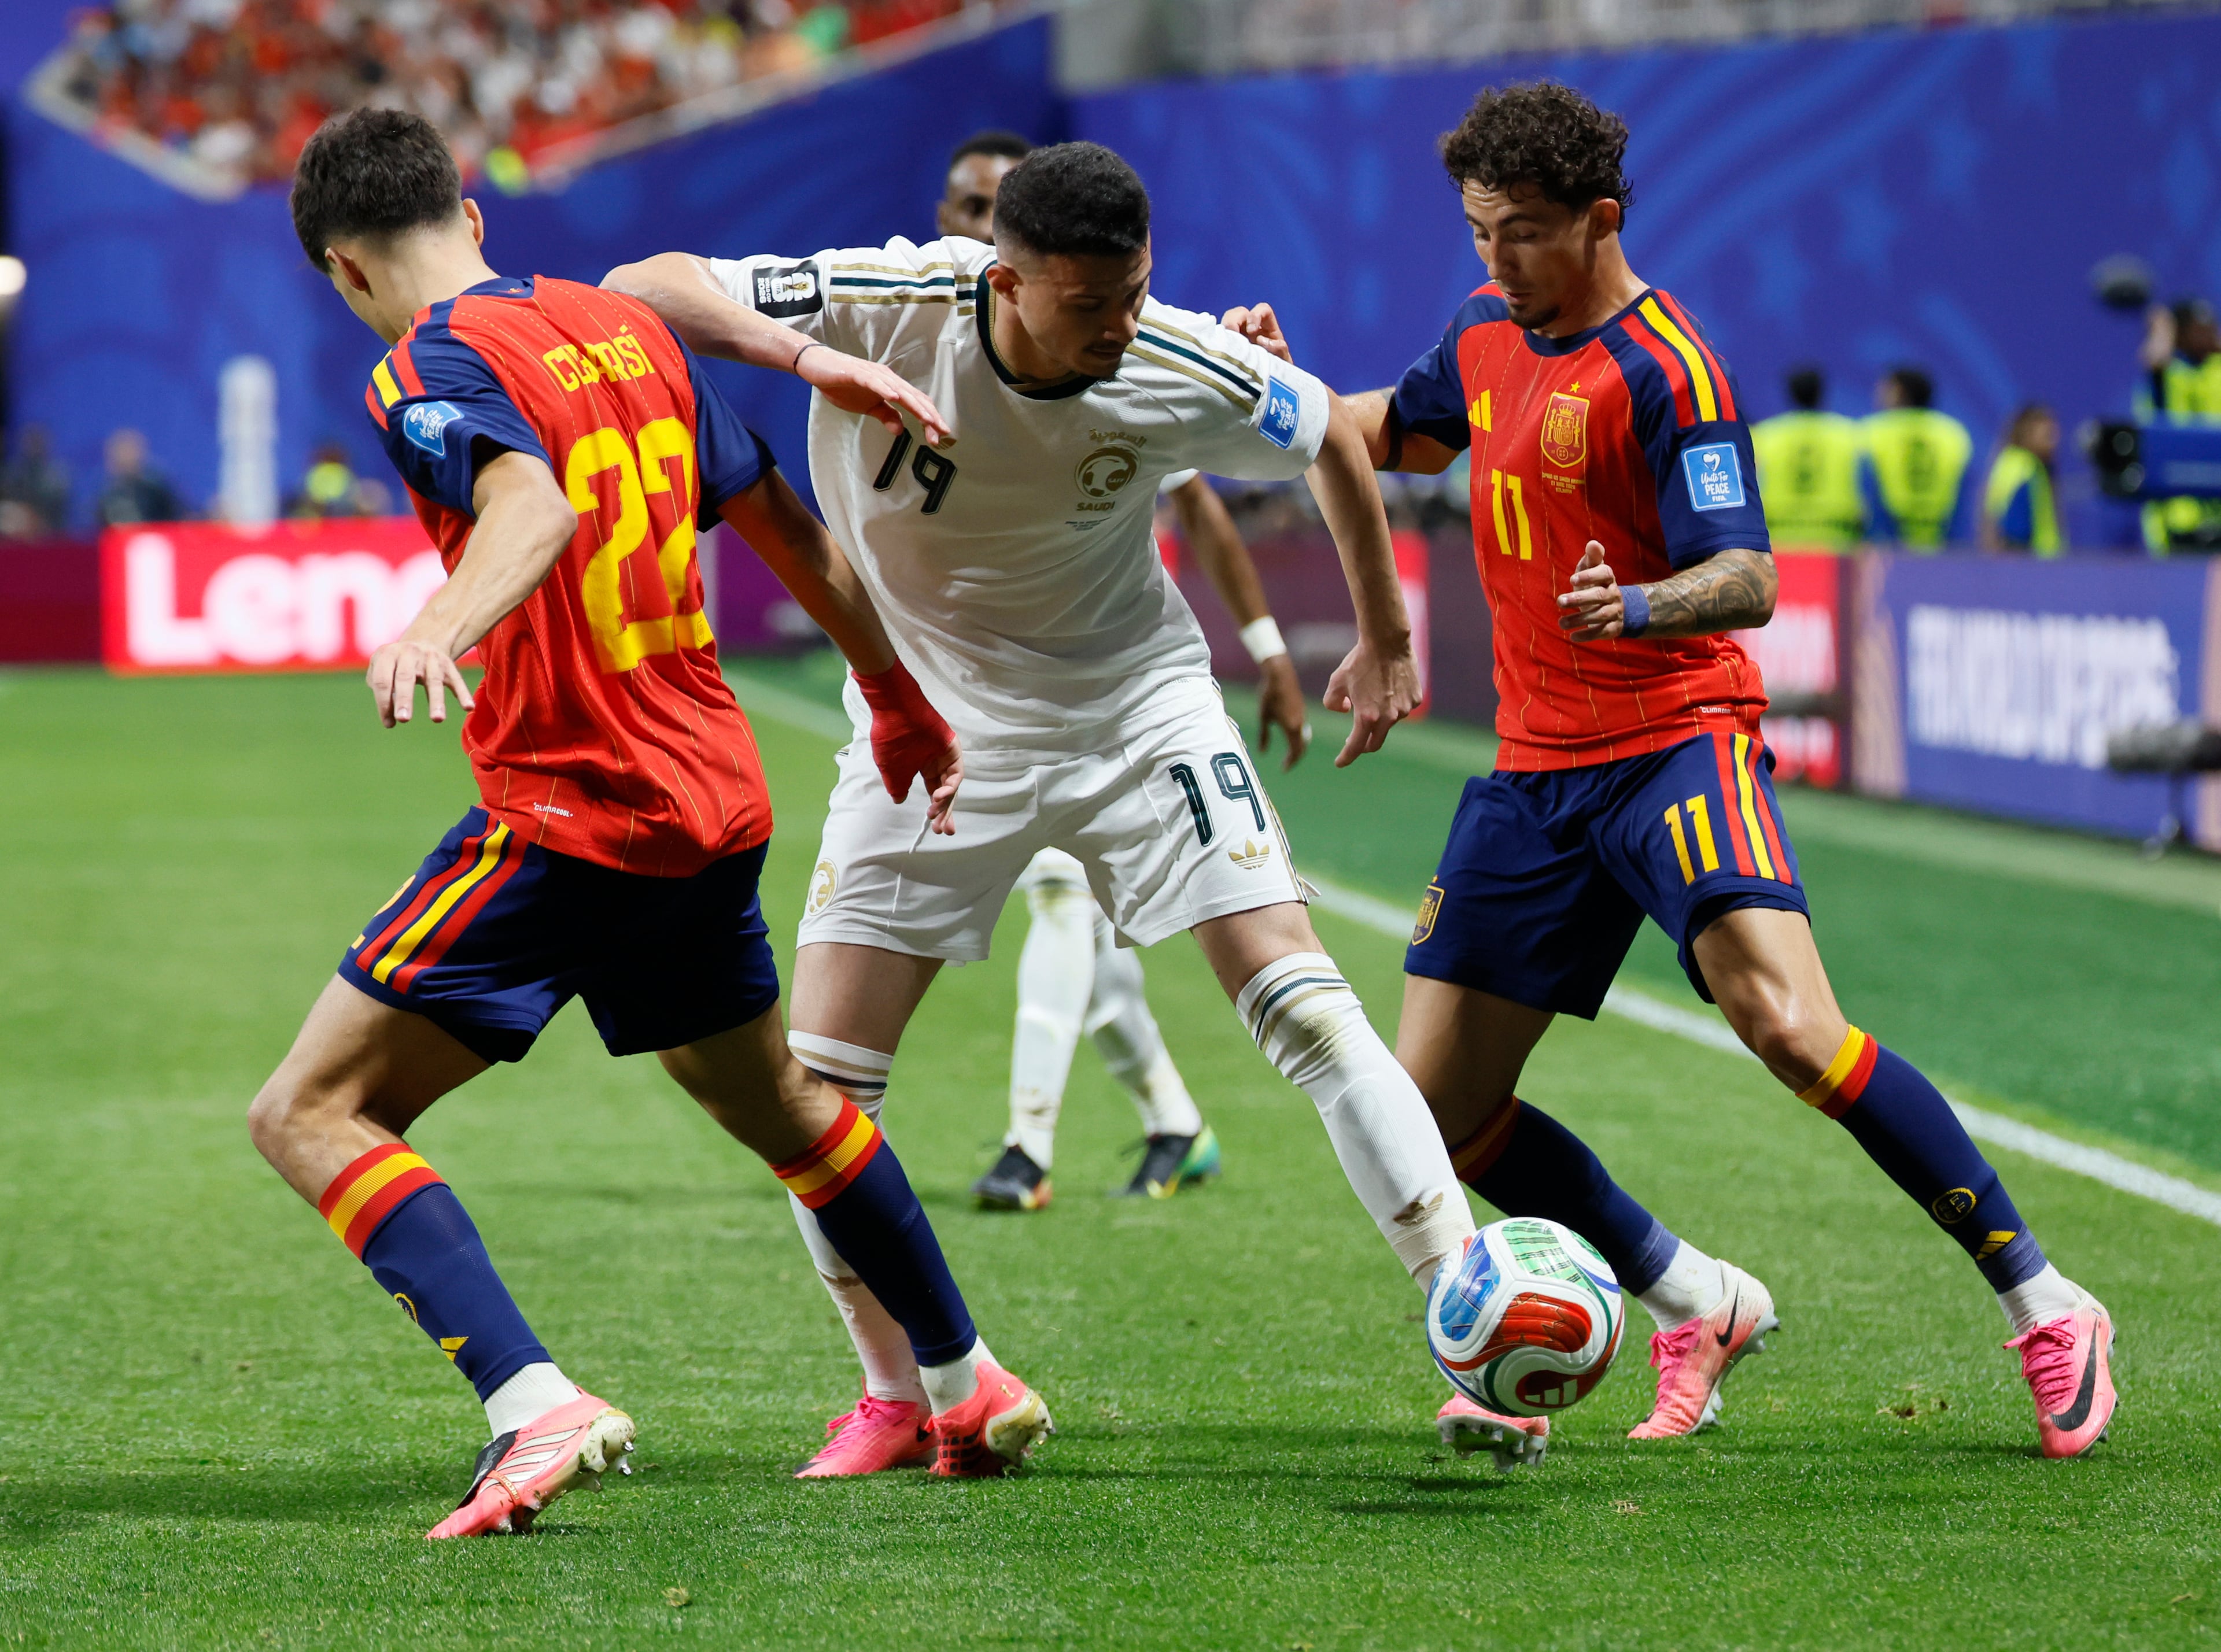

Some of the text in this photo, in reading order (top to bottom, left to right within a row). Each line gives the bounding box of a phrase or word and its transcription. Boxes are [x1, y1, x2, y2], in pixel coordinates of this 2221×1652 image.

[757, 278, 766, 304] 2026
[427, 413, 444, 440] PEACE
[1282, 401, 1293, 431] PEACE
[873, 427, 958, 515] 19
[1701, 471, 1729, 485] Unite For
[1705, 482, 1730, 496] PEACE
[1076, 501, 1115, 511] SAUDI
[1491, 468, 1532, 560] 11
[565, 416, 713, 675] 22
[534, 804, 570, 818] CLIMACOOL
[1169, 752, 1267, 847] 19
[1664, 794, 1720, 886] 11
